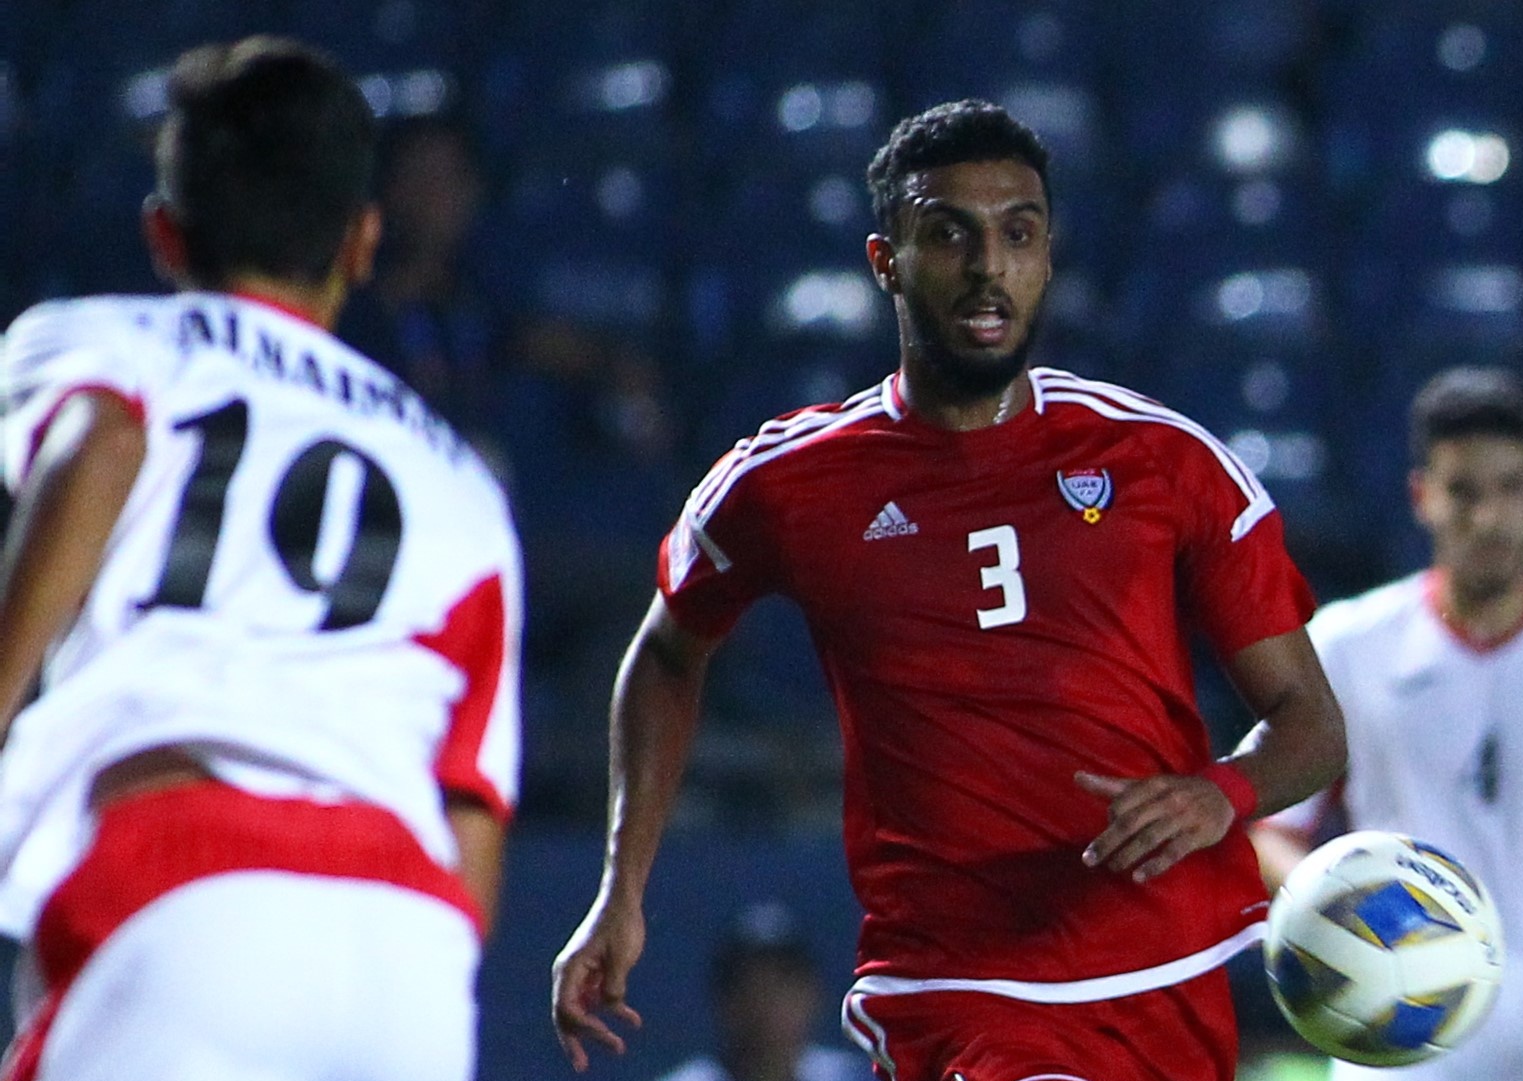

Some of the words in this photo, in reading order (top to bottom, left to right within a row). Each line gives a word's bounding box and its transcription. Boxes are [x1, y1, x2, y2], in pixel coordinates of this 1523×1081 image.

[135, 396, 405, 633] 19
[863, 522, 919, 541] adidas
[967, 524, 1027, 630] 3
